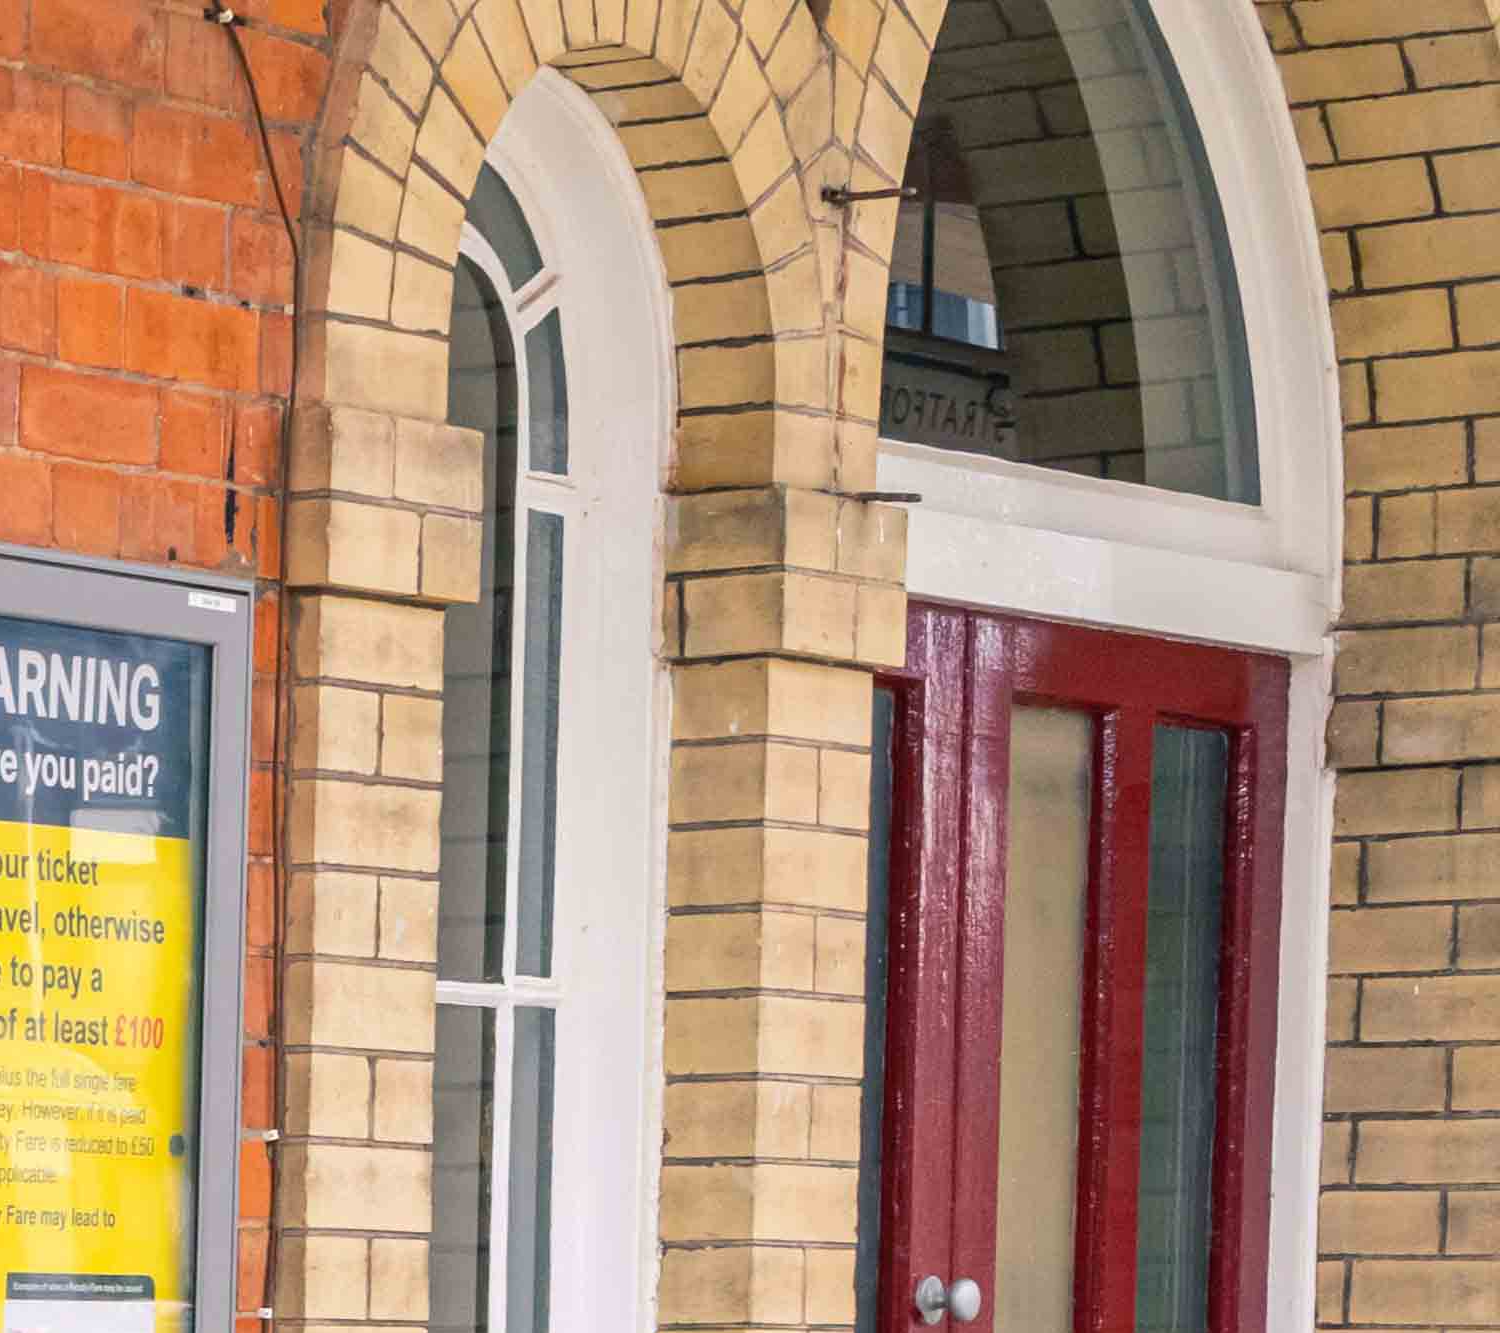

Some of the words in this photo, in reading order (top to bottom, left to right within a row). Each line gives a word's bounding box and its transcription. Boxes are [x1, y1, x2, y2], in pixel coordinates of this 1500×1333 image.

[25, 748, 77, 795] you
[84, 755, 158, 800] paid?
[37, 849, 99, 886] ticket
[53, 907, 165, 945] otherwise
[10, 955, 34, 988] to
[42, 963, 82, 999] pay
[90, 967, 102, 992] a
[24, 1008, 46, 1043] at
[53, 1010, 109, 1046] least
[115, 1015, 165, 1050] £100
[27, 1067, 47, 1089] the
[6, 1204, 37, 1226] Fare
[40, 1210, 66, 1232] may
[71, 1207, 100, 1228] lead
[103, 1208, 116, 1228] to
